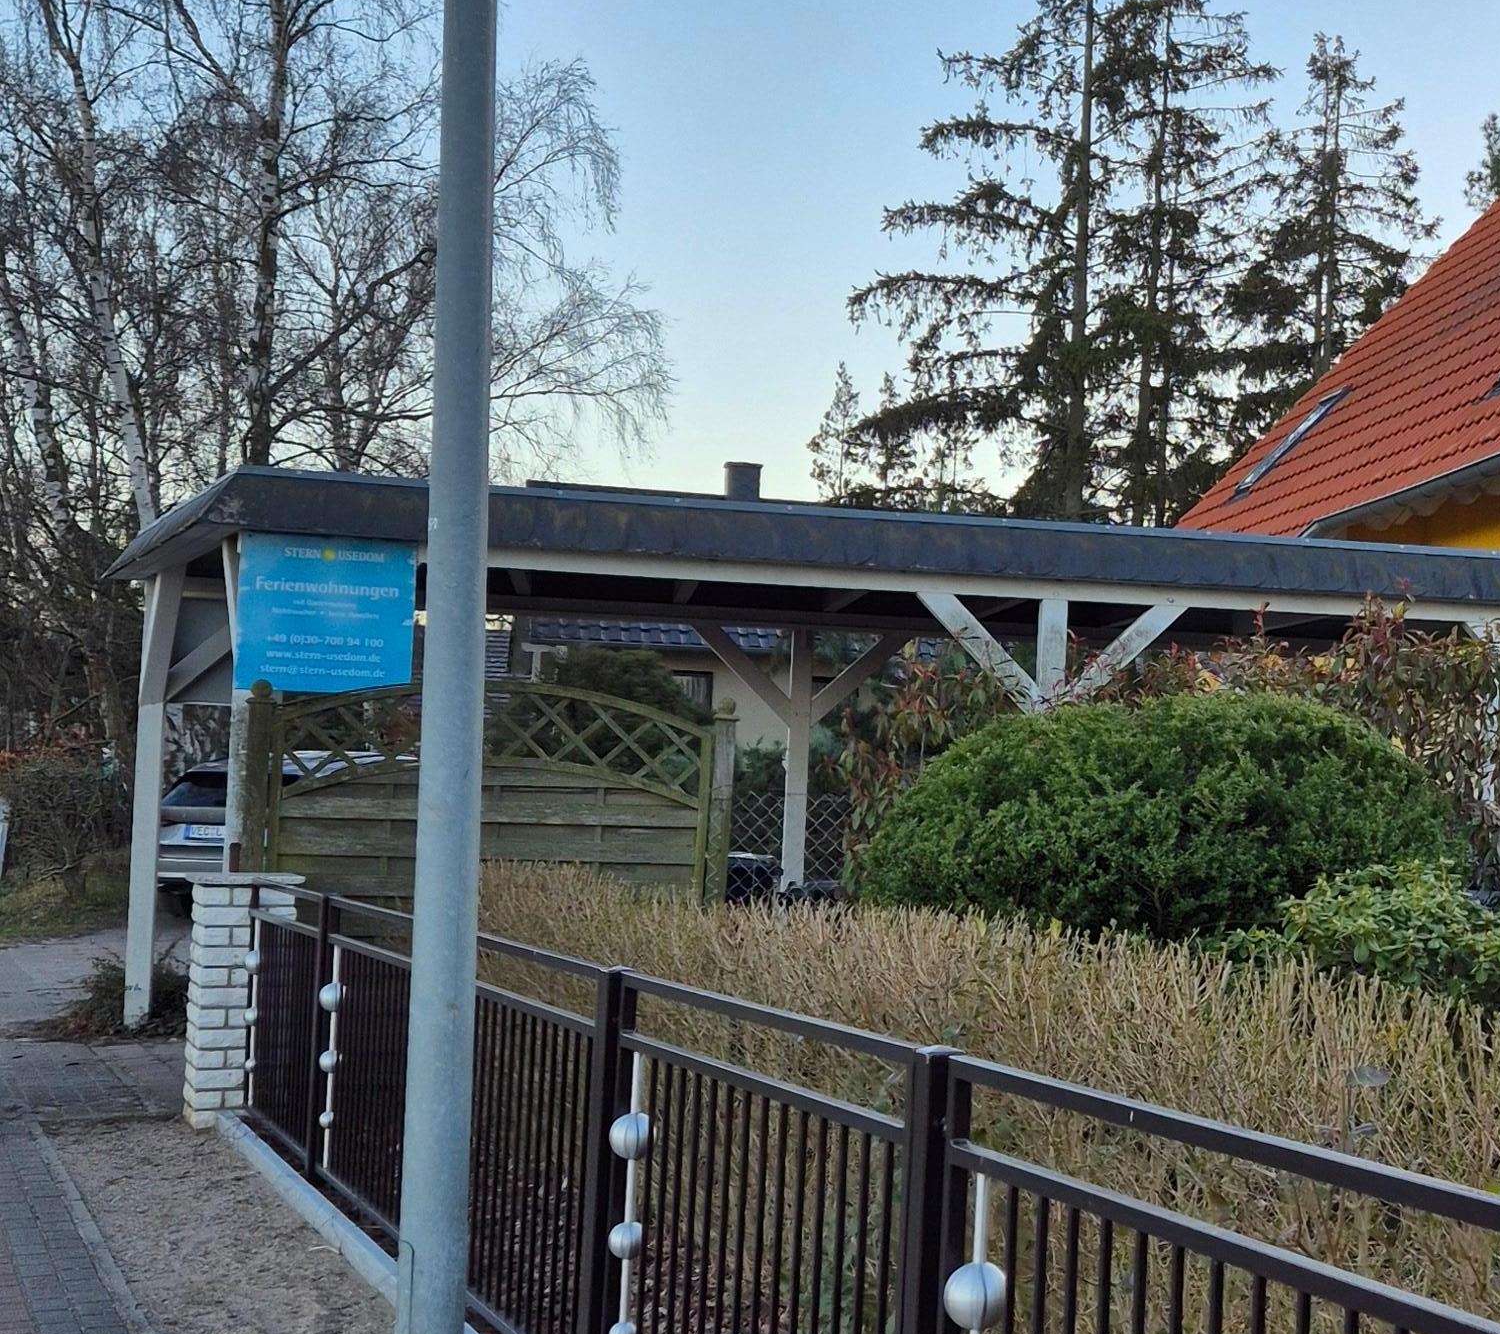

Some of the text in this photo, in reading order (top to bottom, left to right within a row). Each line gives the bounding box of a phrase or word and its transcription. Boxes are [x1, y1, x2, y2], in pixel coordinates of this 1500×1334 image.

[284, 547, 385, 563] STERN USEDOM
[255, 576, 400, 600] Ferienwohnungen
[347, 638, 360, 647] 94
[266, 650, 381, 664] www.stern-usedom.de
